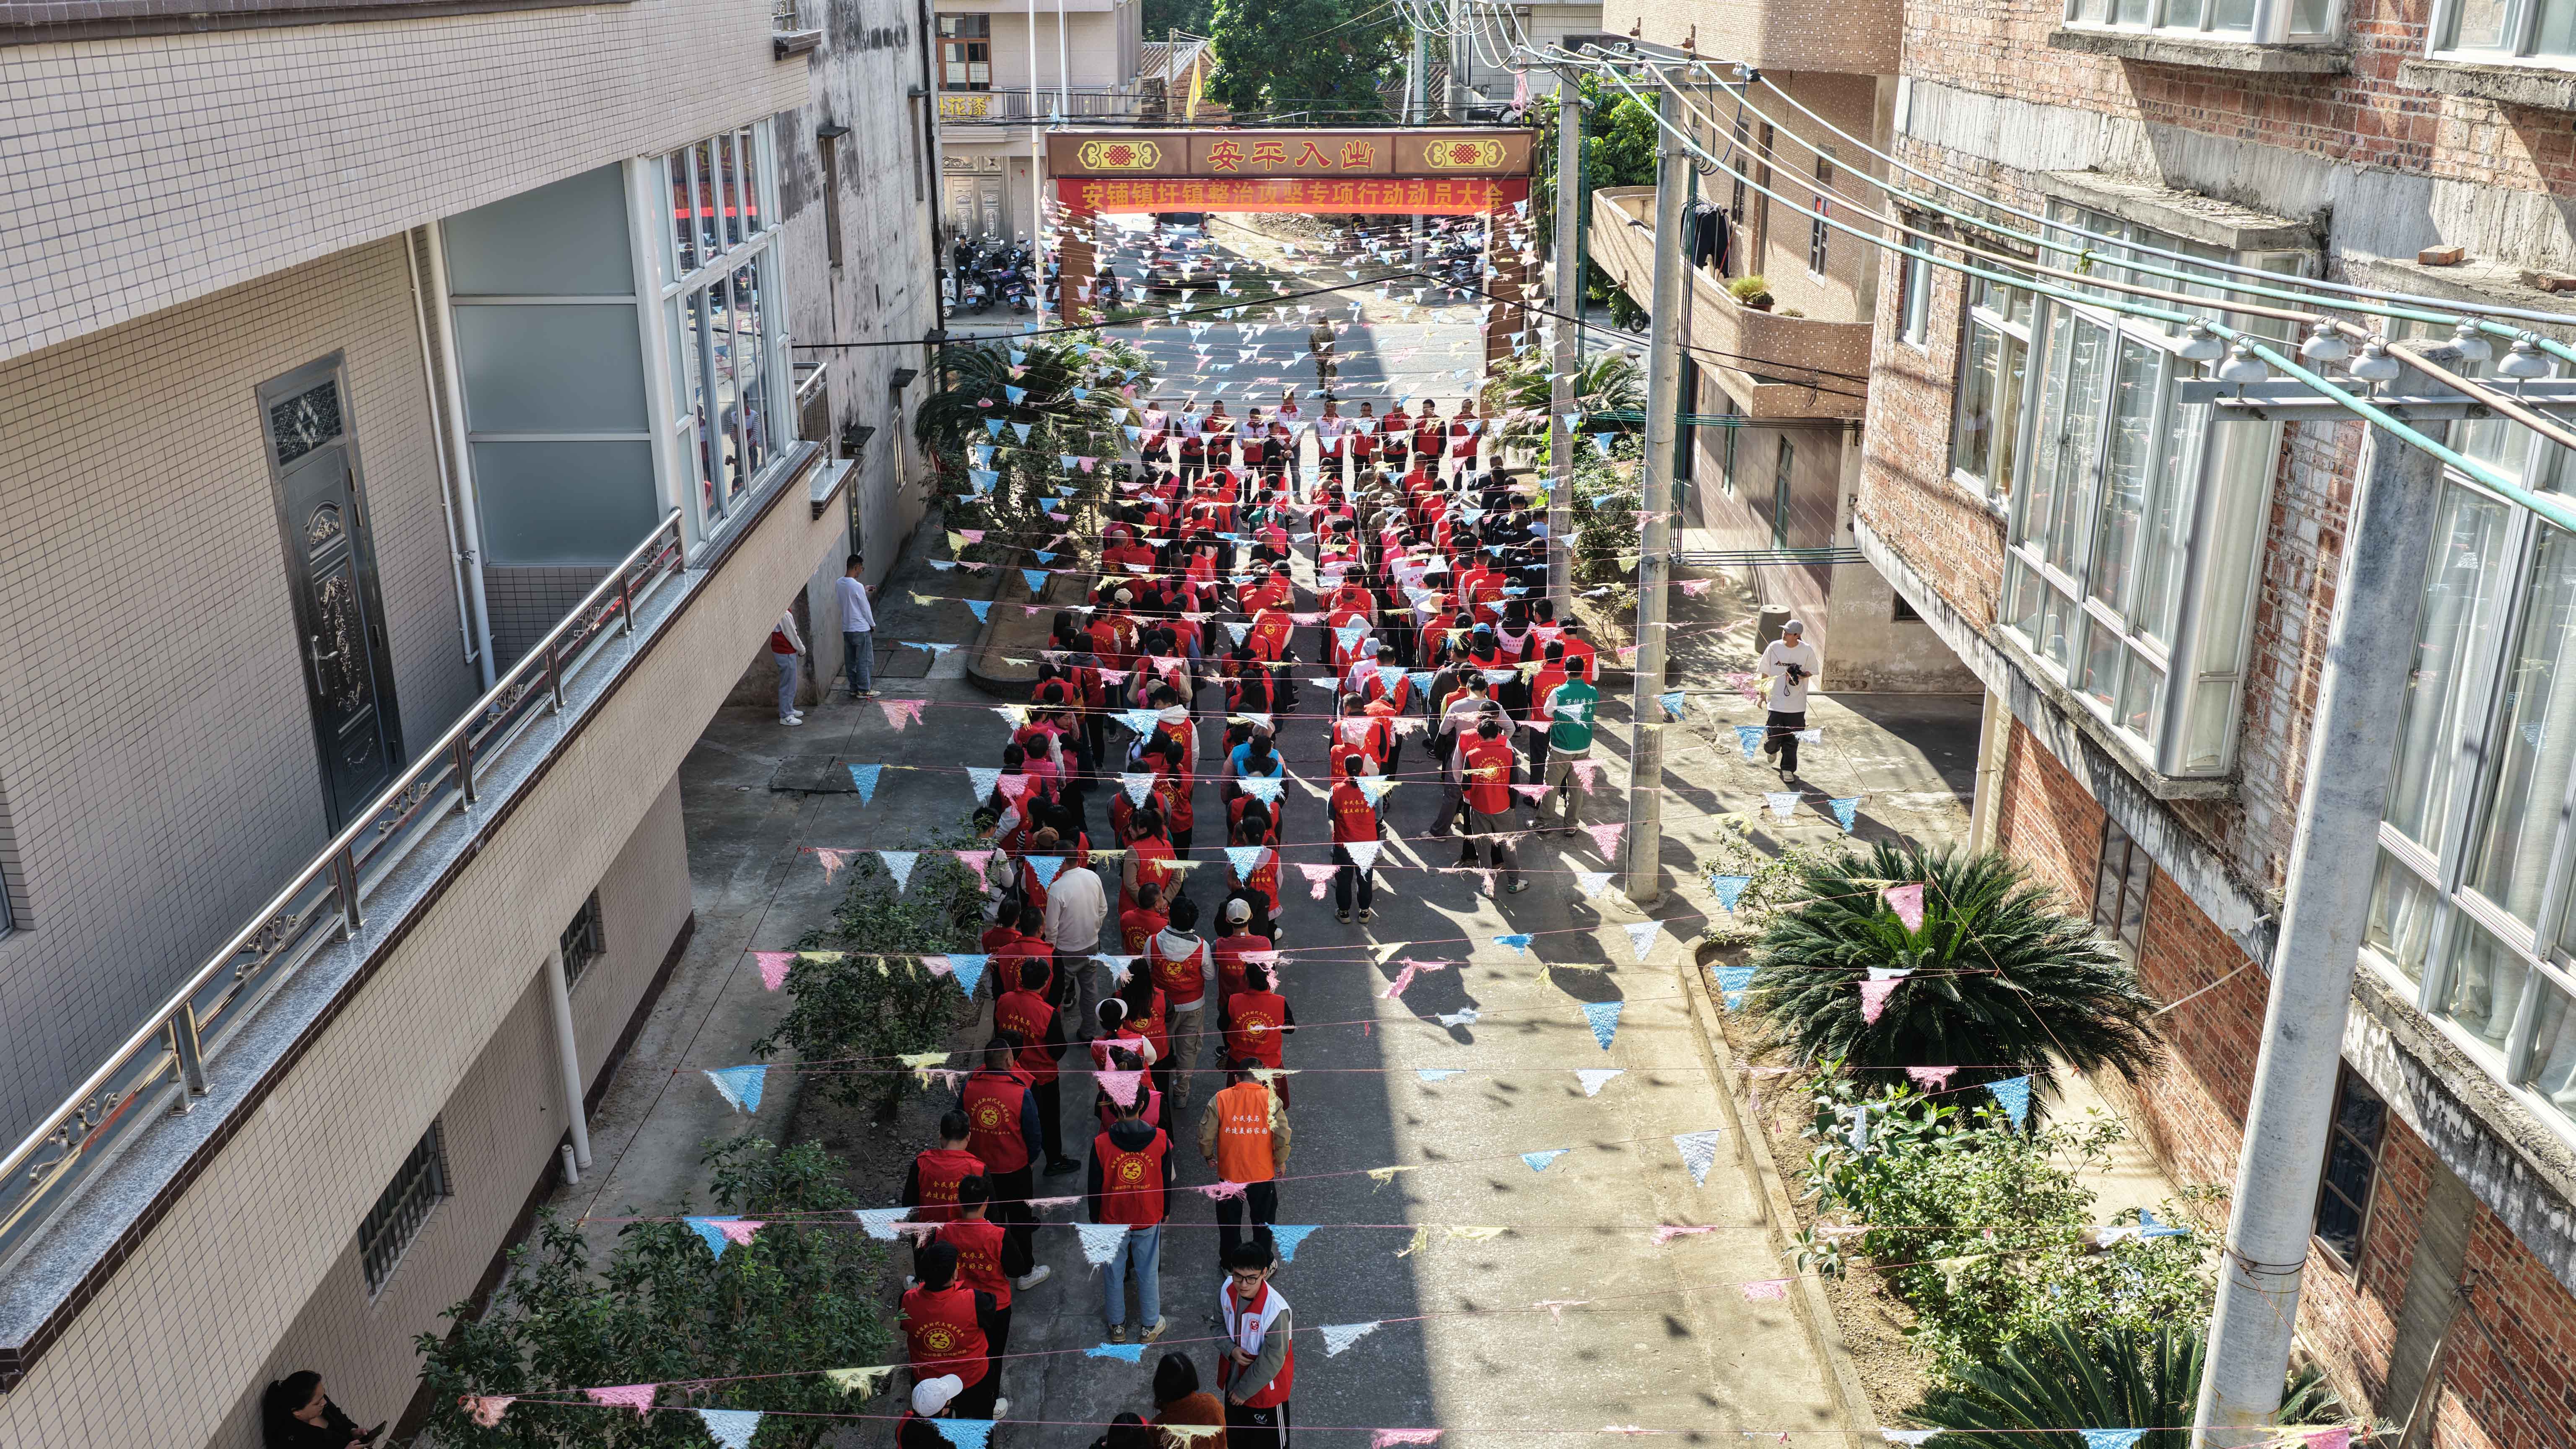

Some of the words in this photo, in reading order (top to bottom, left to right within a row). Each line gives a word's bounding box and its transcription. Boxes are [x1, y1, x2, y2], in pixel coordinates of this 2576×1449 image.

[1082, 181, 1504, 210] 安铺镇圩镇整治攻坚专项行动动员大会
[1231, 1114, 1259, 1123] 全民参与
